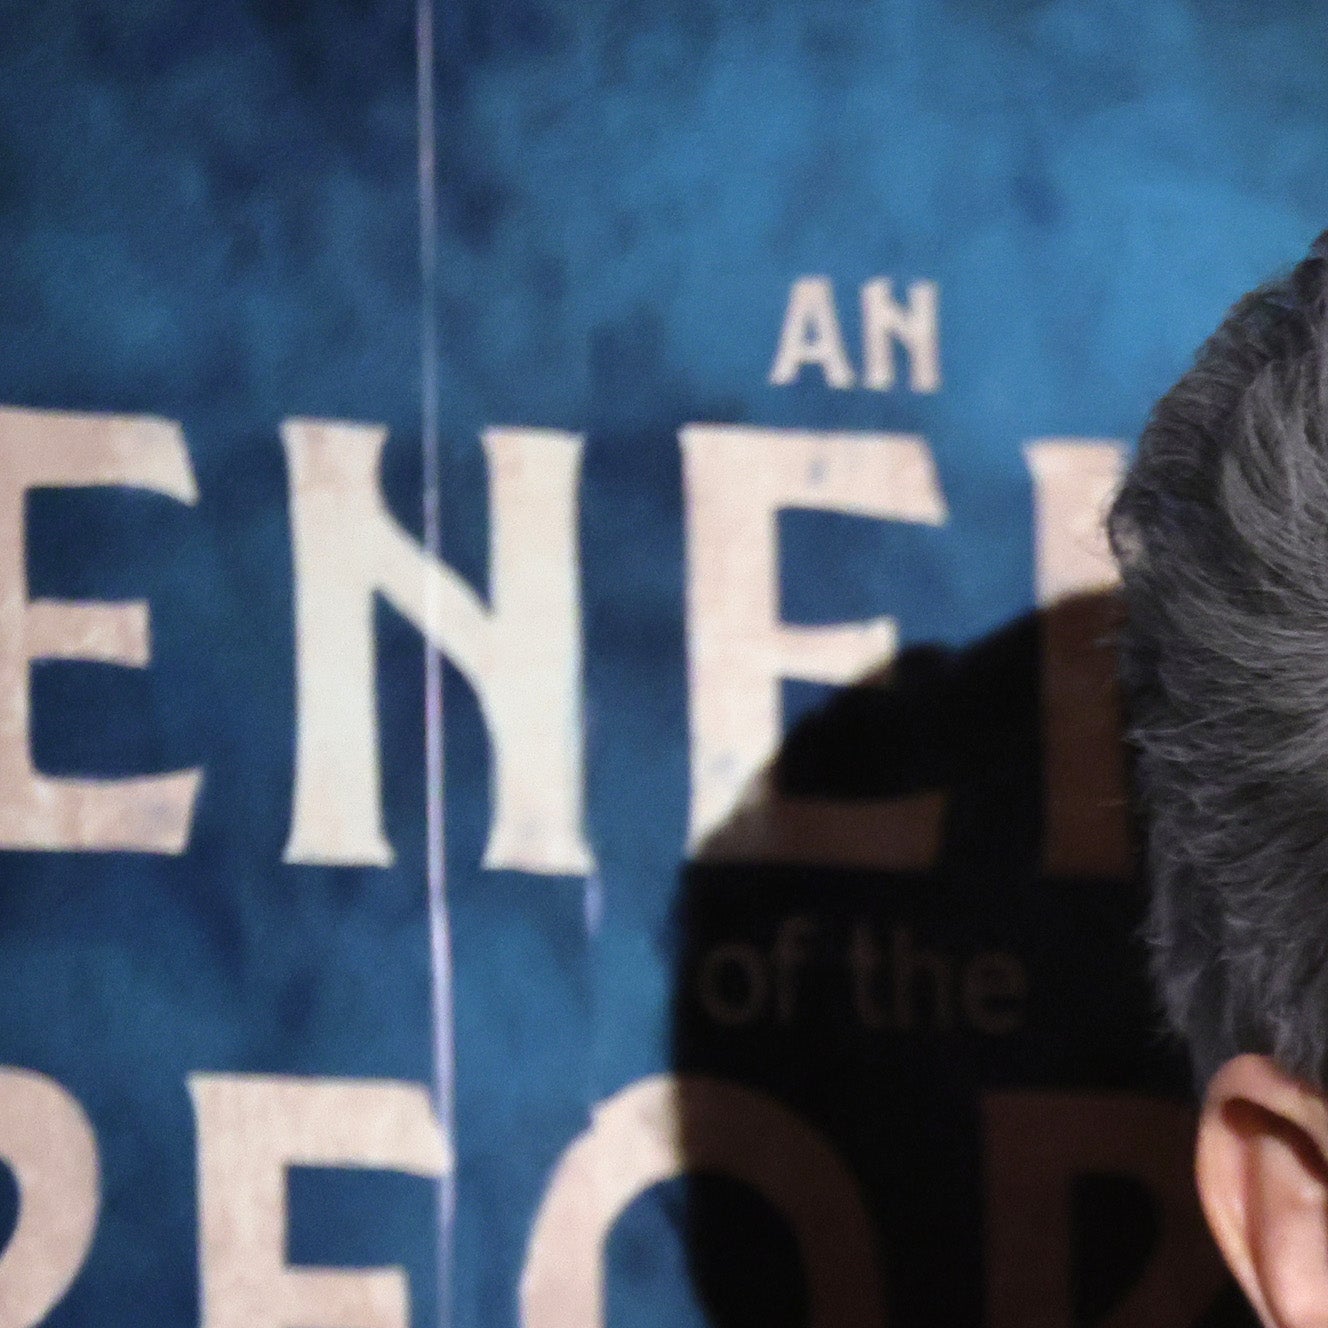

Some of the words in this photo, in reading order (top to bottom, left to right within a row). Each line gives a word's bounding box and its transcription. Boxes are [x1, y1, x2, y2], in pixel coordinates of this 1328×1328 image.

[768, 276, 941, 392] AN
[698, 916, 814, 1029] of
[847, 923, 1030, 1035] the
